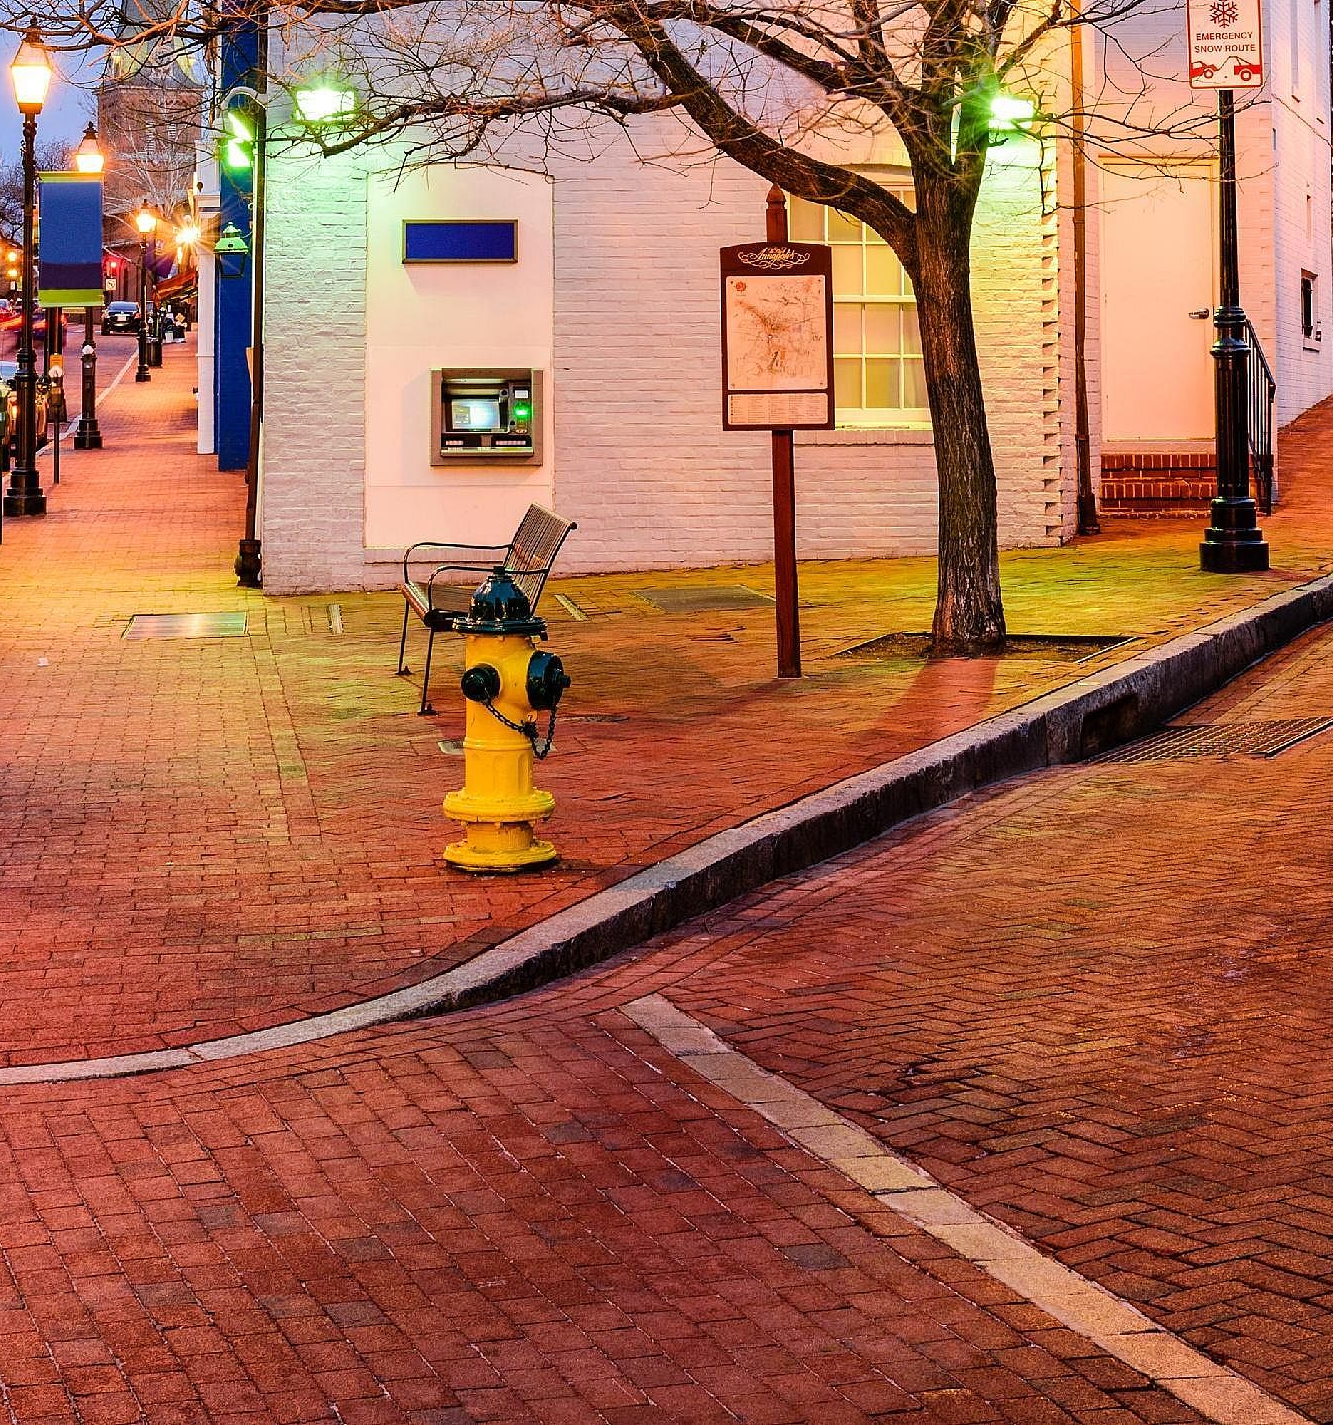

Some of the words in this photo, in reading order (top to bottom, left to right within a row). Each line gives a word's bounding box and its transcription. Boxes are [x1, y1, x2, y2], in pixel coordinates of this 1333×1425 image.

[1196, 31, 1253, 41] EMERGENCY
[1194, 45, 1222, 53] SNOW
[1225, 44, 1257, 52] ROUTE
